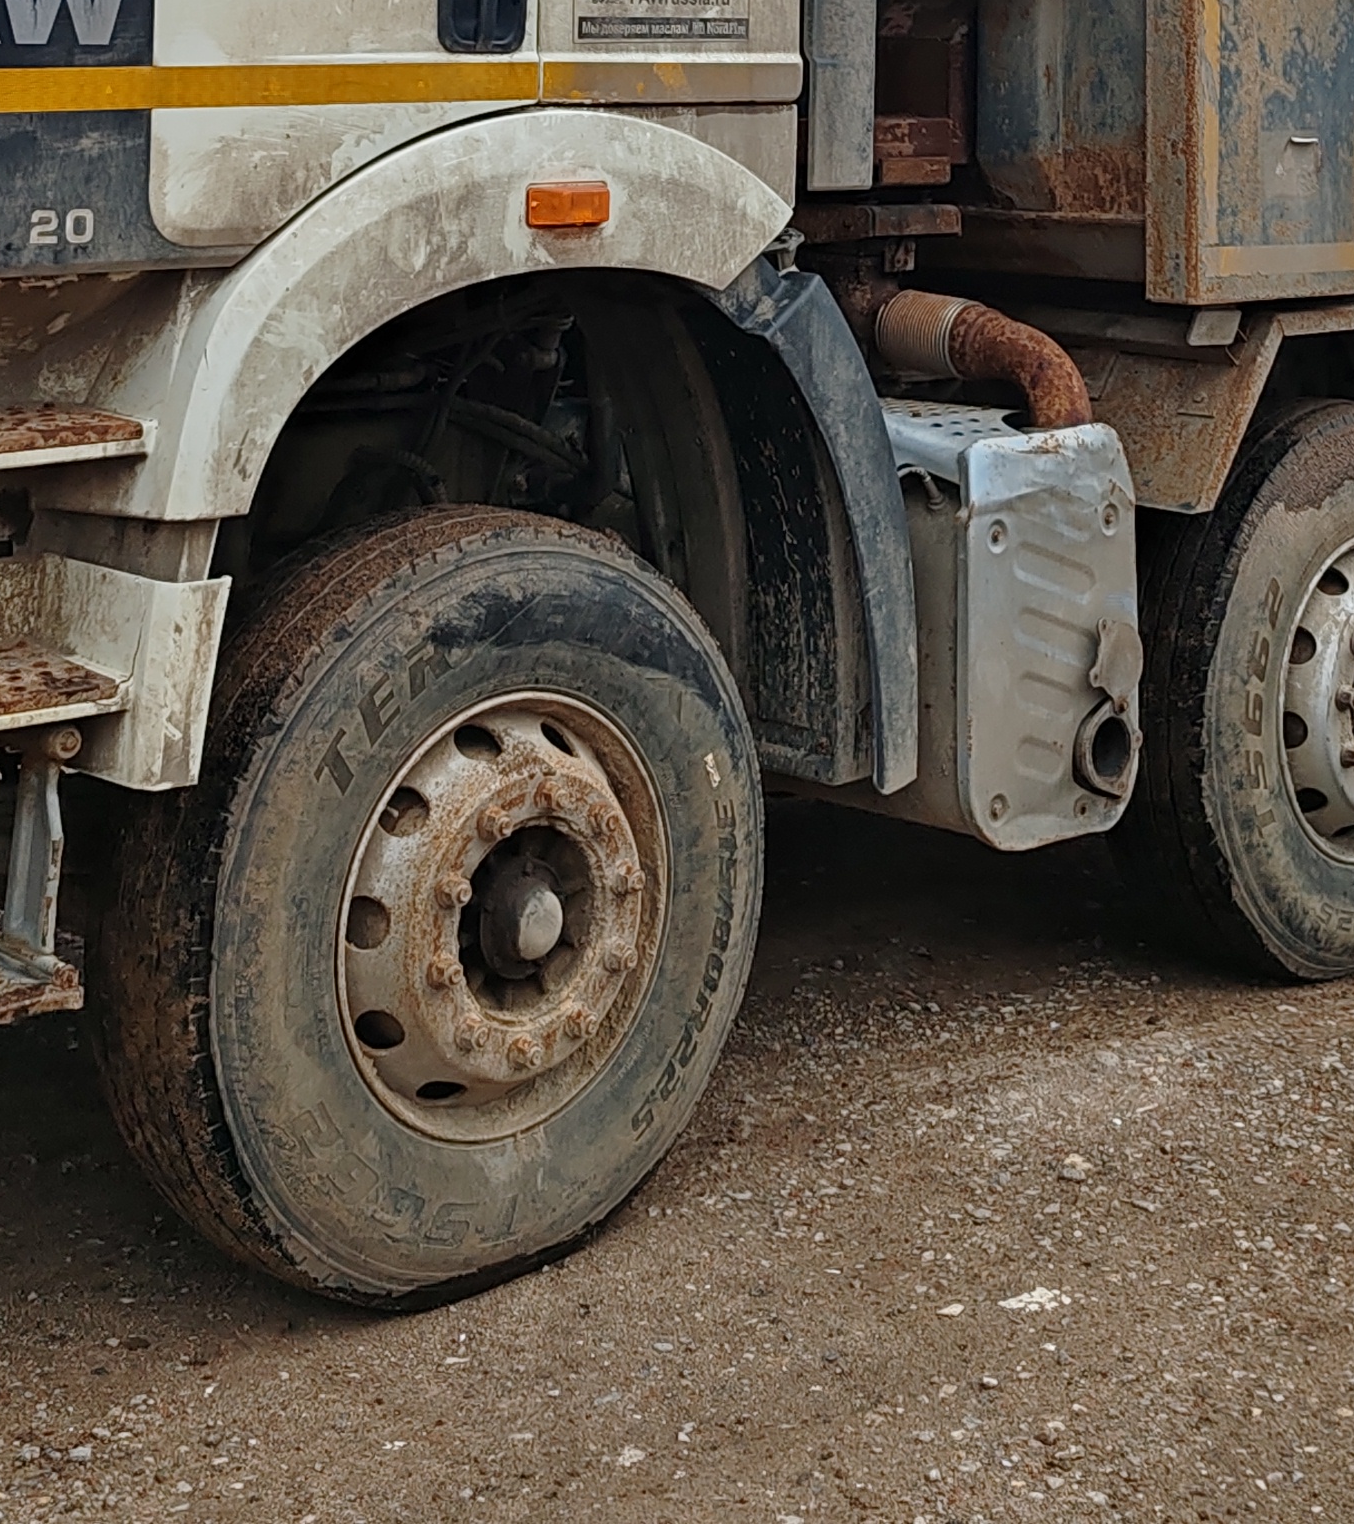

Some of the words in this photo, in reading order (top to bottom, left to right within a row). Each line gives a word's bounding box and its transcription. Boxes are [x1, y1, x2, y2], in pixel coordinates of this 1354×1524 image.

[581, 21, 600, 34] Мы
[601, 22, 649, 37] доверяем
[651, 22, 690, 35] маслам
[28, 208, 94, 245] 20
